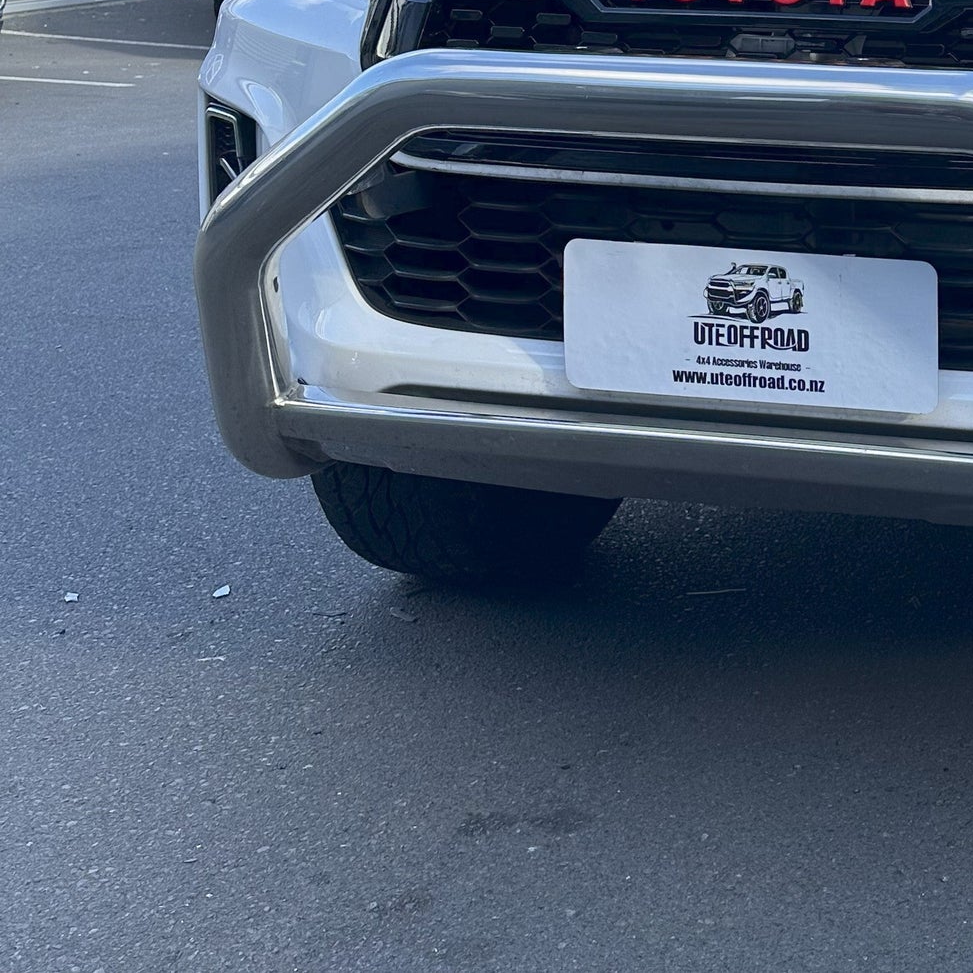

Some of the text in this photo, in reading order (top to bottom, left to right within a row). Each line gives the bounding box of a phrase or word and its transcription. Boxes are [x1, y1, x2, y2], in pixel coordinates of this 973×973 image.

[695, 355, 802, 372] 4x4 Accessories Warehouse
[672, 369, 826, 393] www.uteoffroad.co.nz
